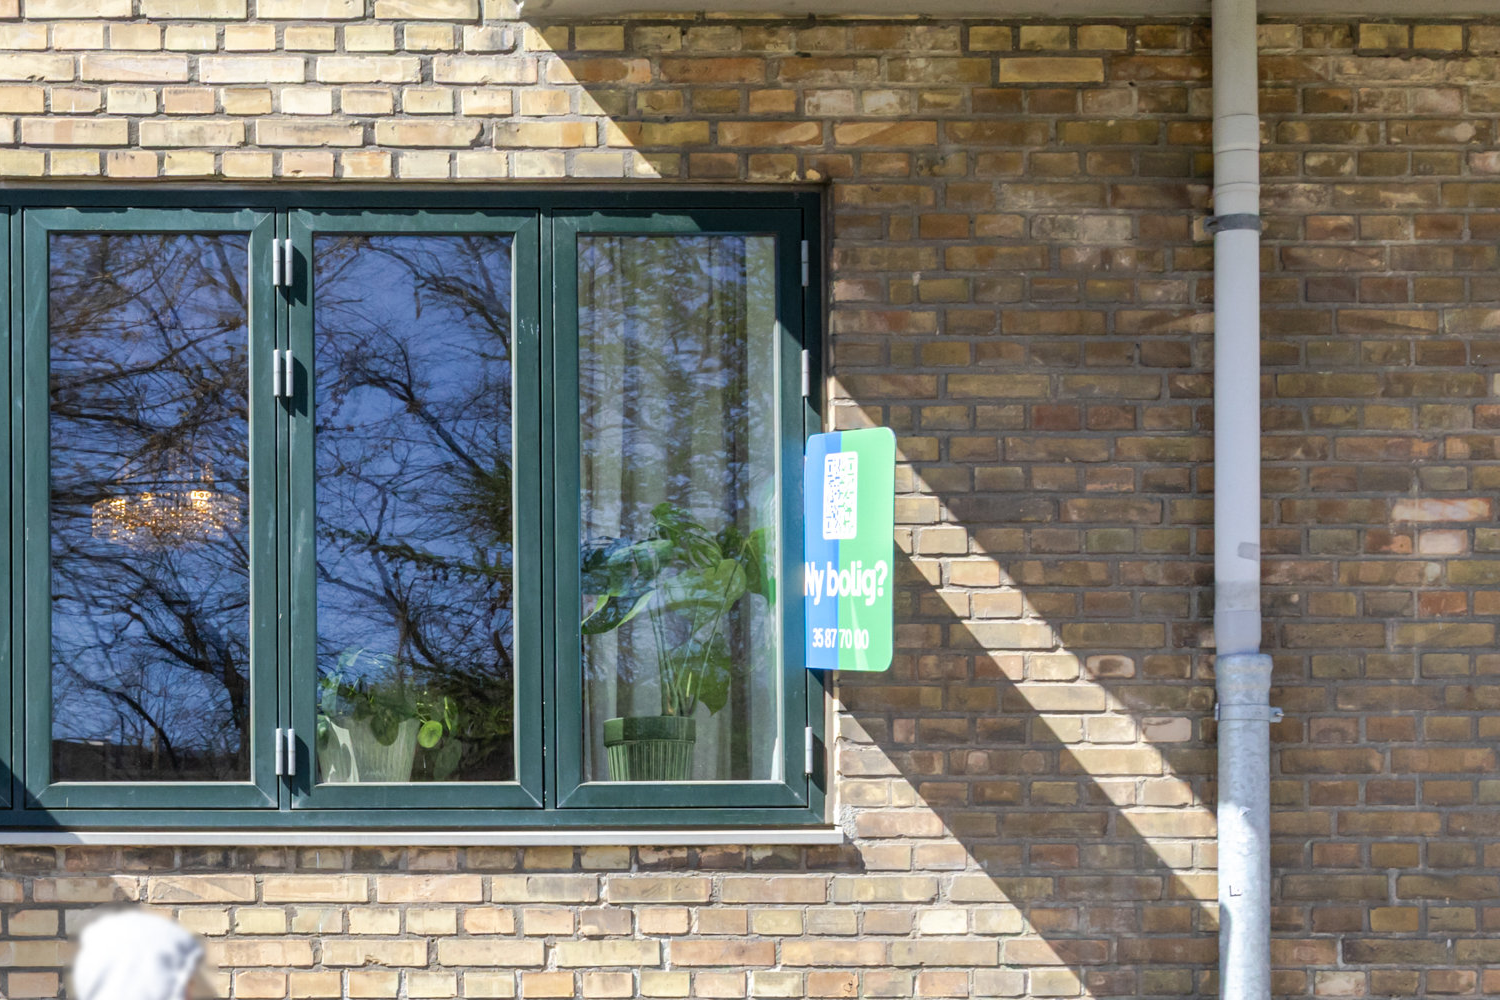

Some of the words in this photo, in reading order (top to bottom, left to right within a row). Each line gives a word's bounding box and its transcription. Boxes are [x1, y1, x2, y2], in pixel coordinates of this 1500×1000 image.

[804, 561, 824, 606] Ny
[826, 560, 888, 606] bolig?
[812, 627, 824, 648] 35
[825, 628, 837, 648] 87
[839, 628, 852, 649] 70
[854, 628, 869, 650] 00
